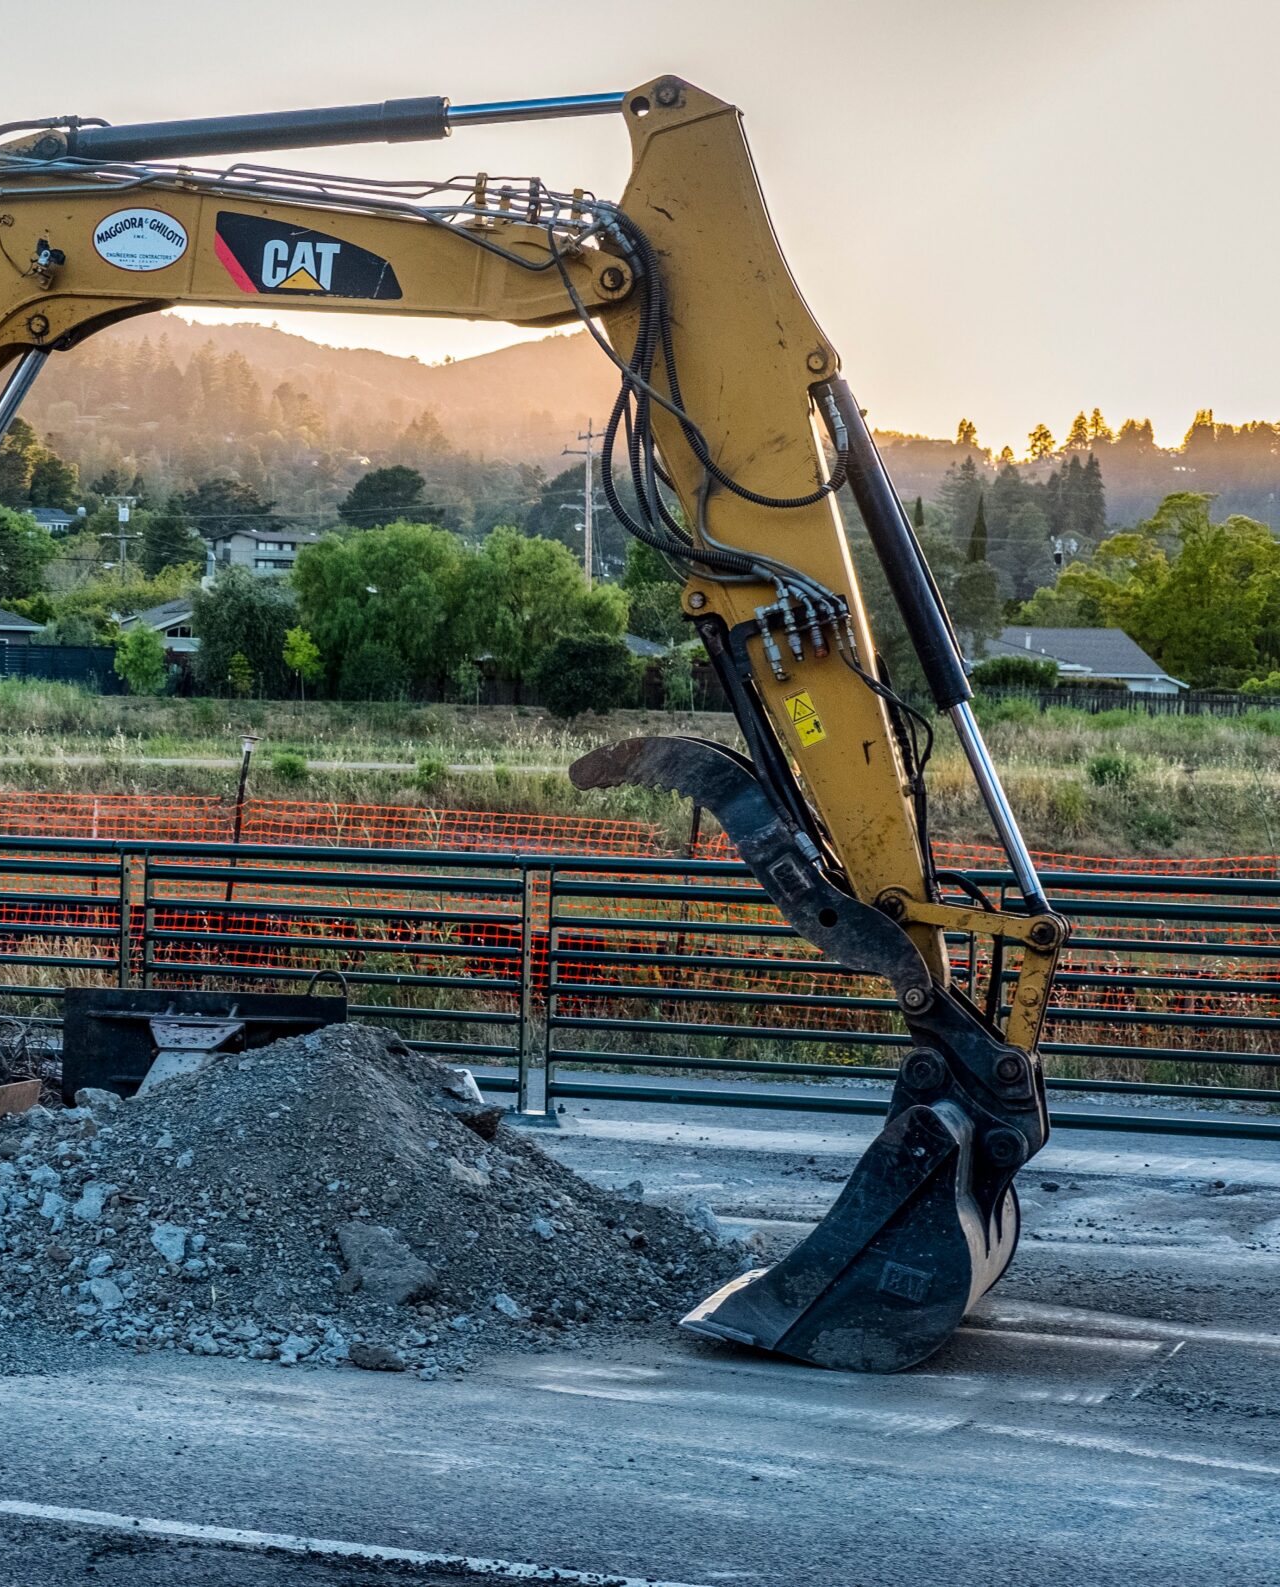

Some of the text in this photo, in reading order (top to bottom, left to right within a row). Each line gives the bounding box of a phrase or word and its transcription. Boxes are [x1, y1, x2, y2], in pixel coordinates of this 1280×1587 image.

[97, 217, 144, 244] MAGGIORA
[149, 219, 184, 248] GHILOTTI
[261, 239, 341, 291] CAT
